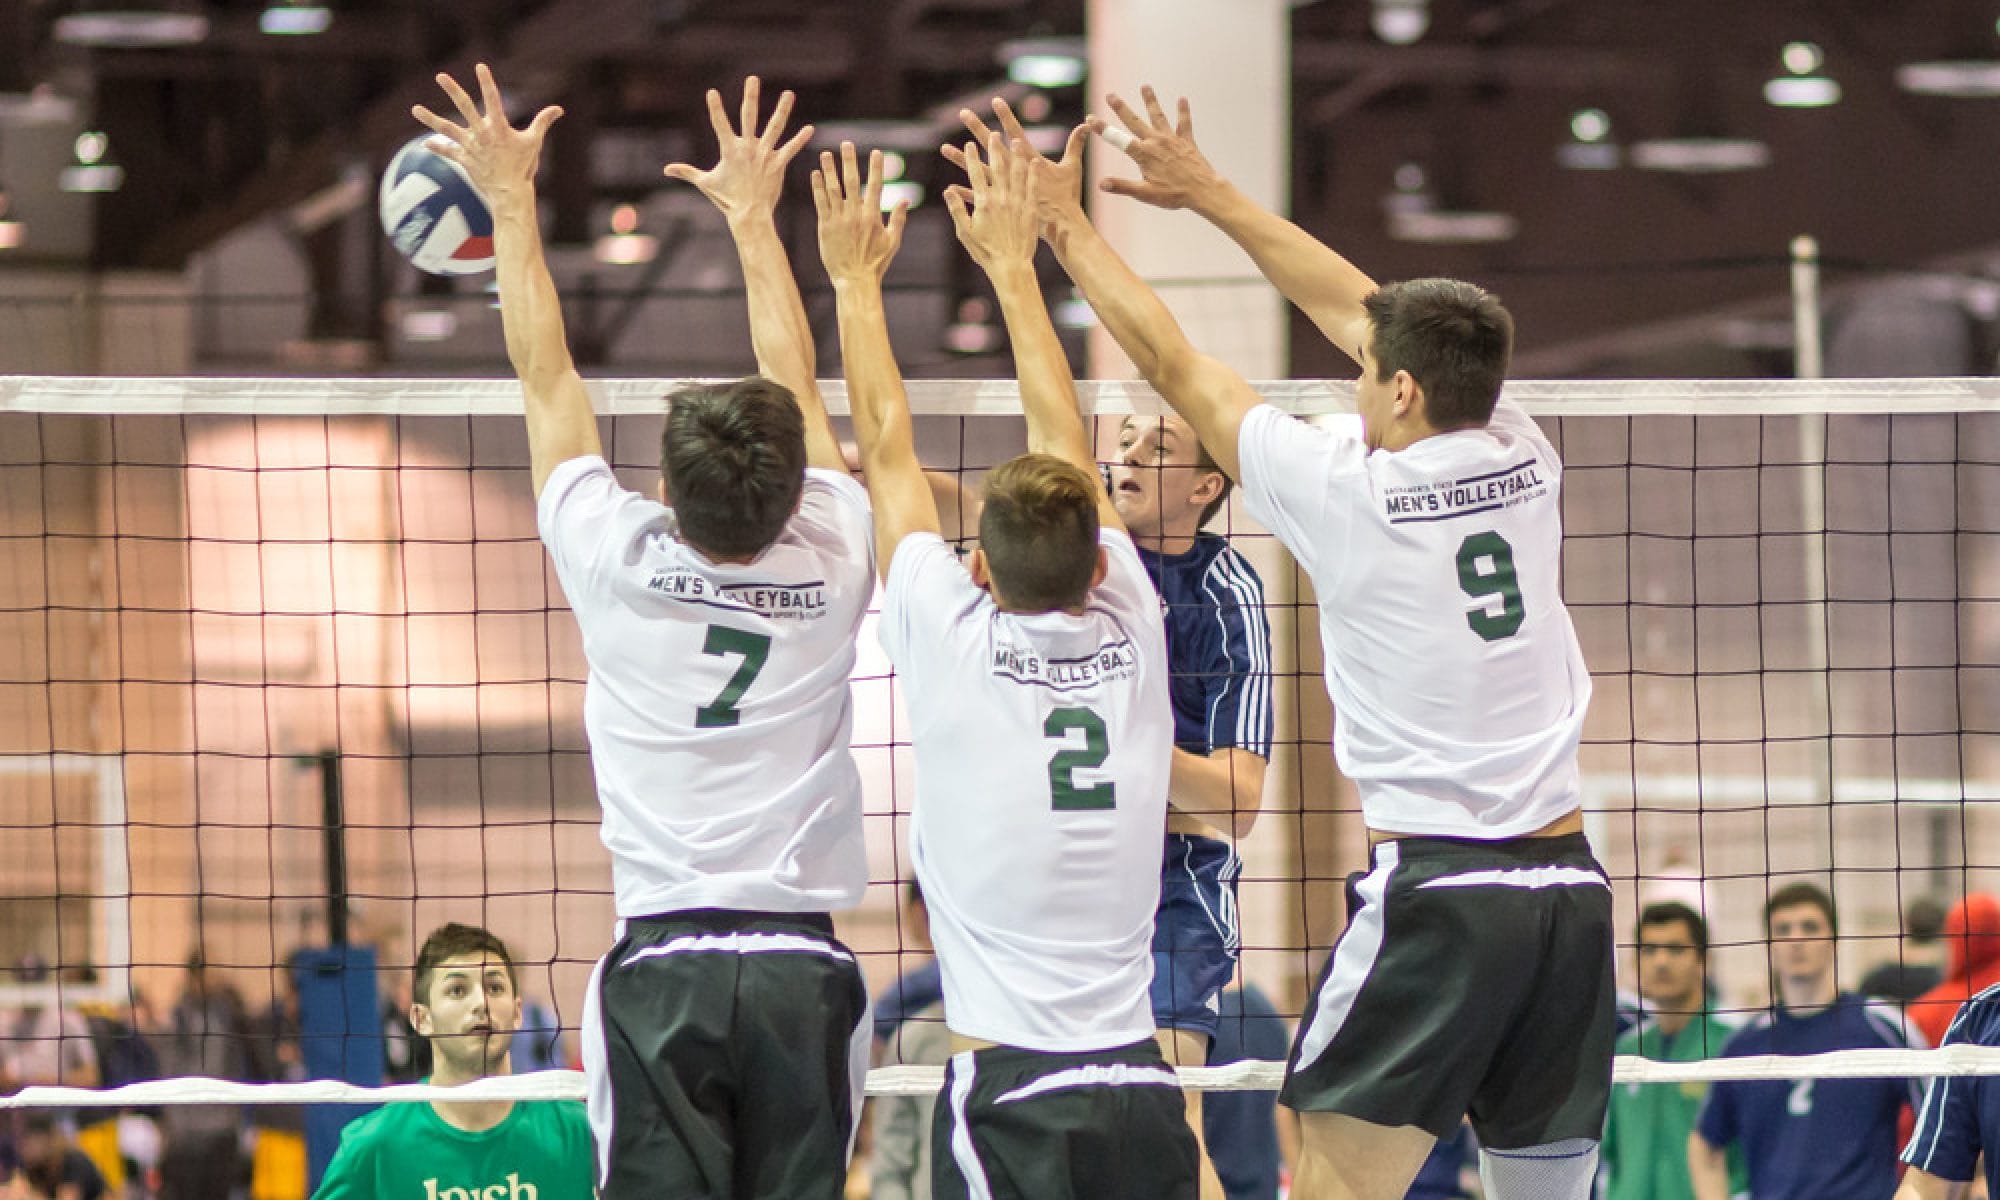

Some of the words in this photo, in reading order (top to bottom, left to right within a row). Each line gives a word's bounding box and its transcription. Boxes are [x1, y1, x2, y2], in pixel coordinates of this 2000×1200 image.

[1387, 493, 1439, 515] MEN'S
[1442, 469, 1544, 508] VOLLEYBALL
[648, 575, 704, 595] MEN'S
[1456, 530, 1526, 642] 9
[695, 624, 772, 728] 7
[1043, 706, 1117, 811] 2
